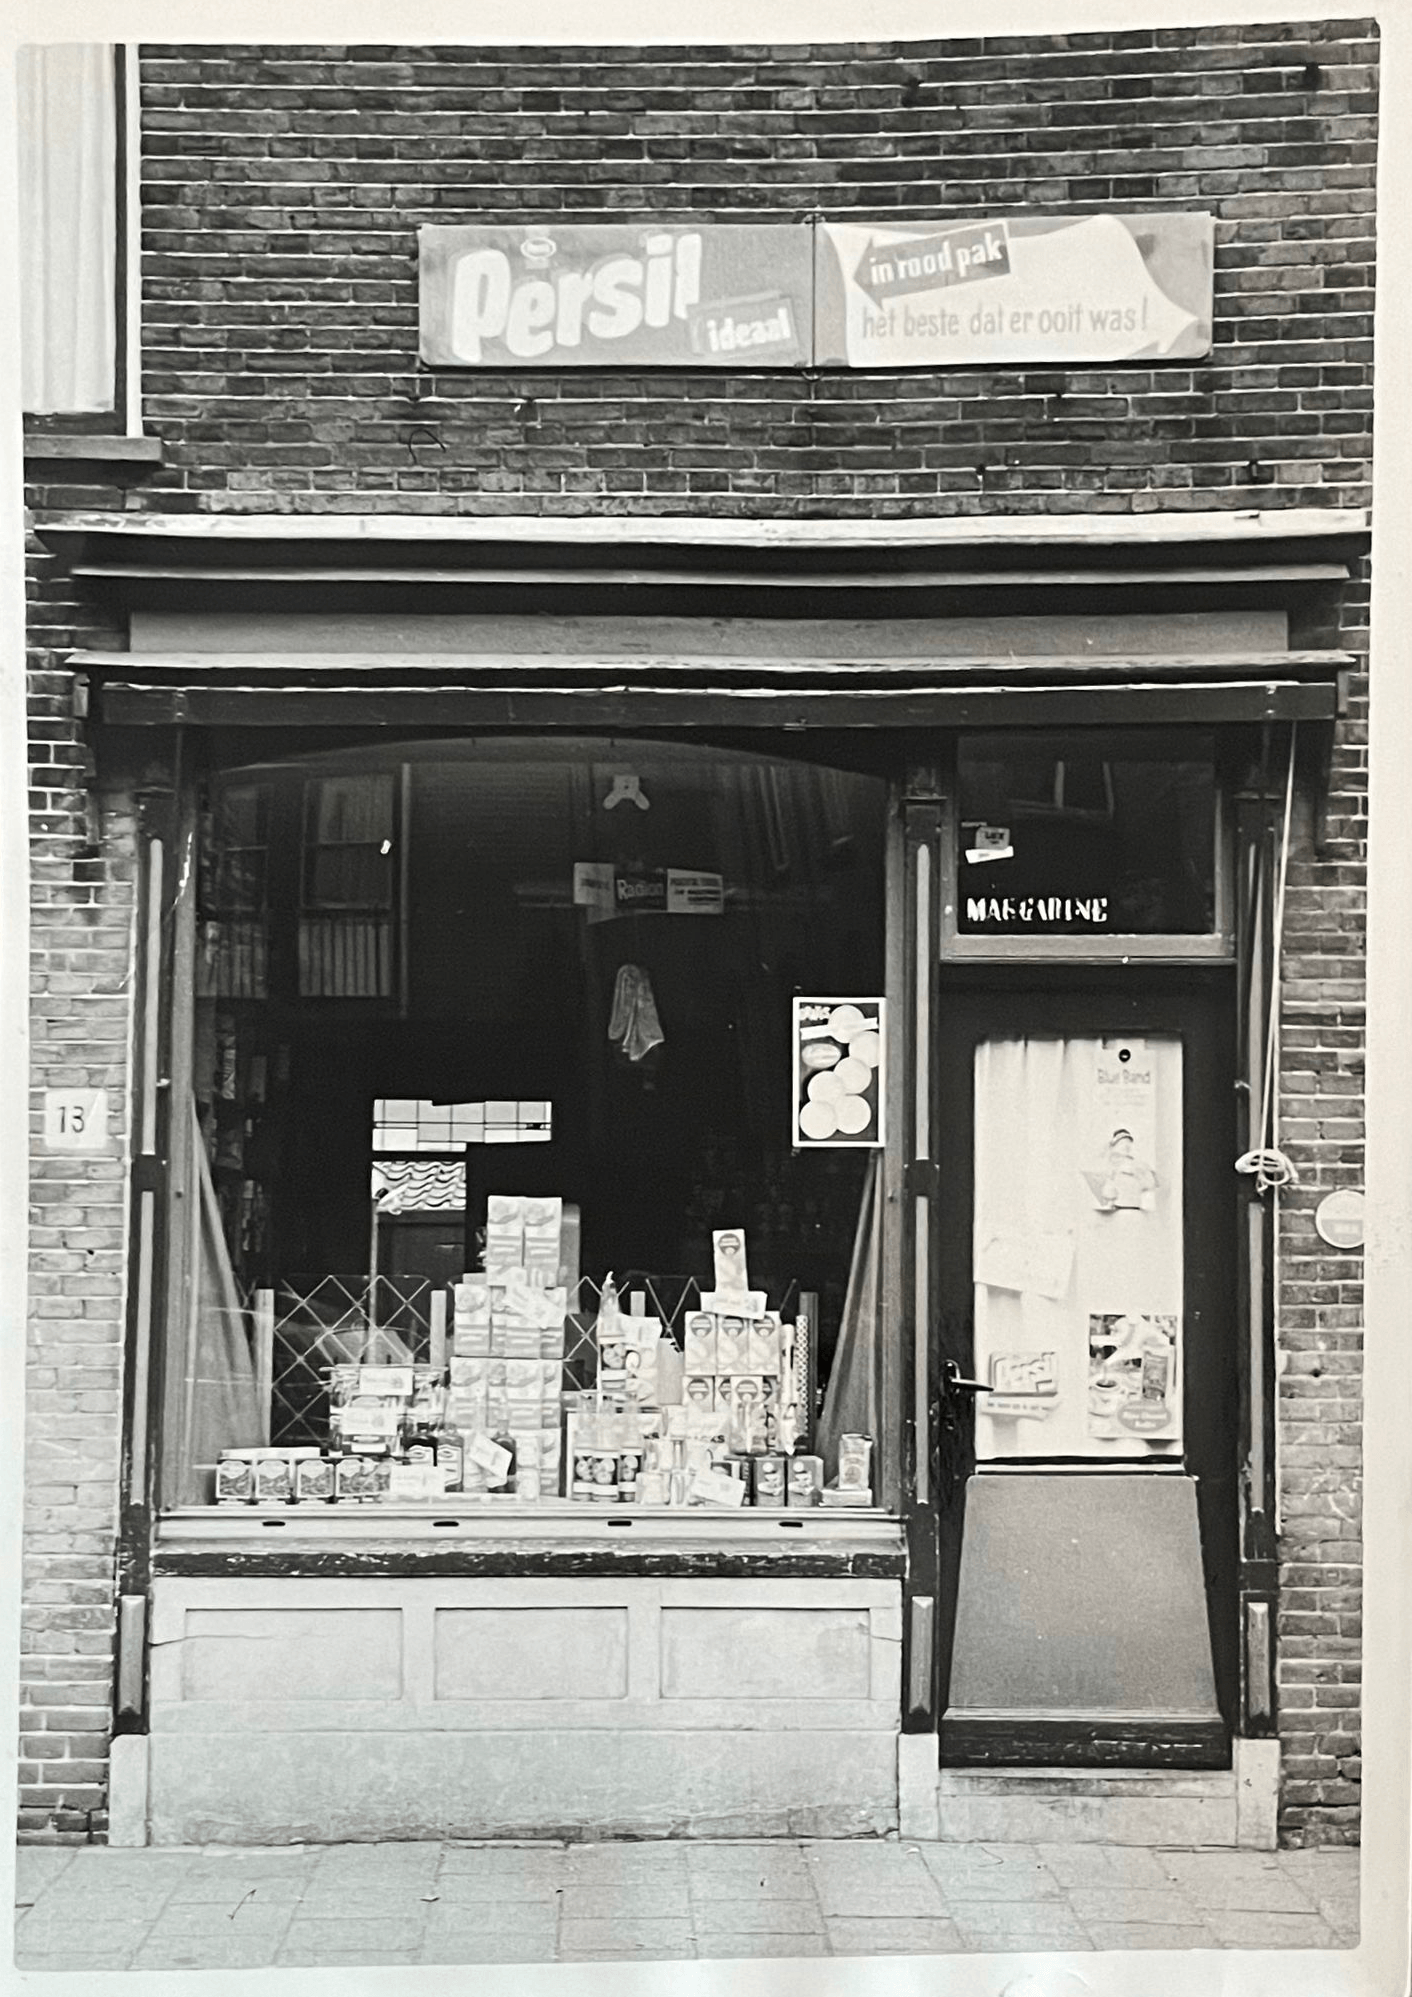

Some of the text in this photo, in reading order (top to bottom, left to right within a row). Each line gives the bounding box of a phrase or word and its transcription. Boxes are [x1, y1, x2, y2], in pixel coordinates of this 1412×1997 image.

[869, 232, 1003, 285] in rood pak
[450, 233, 702, 363] Persil
[862, 296, 1148, 338] het beste dat er ooit was!
[58, 1106, 85, 1133] 13
